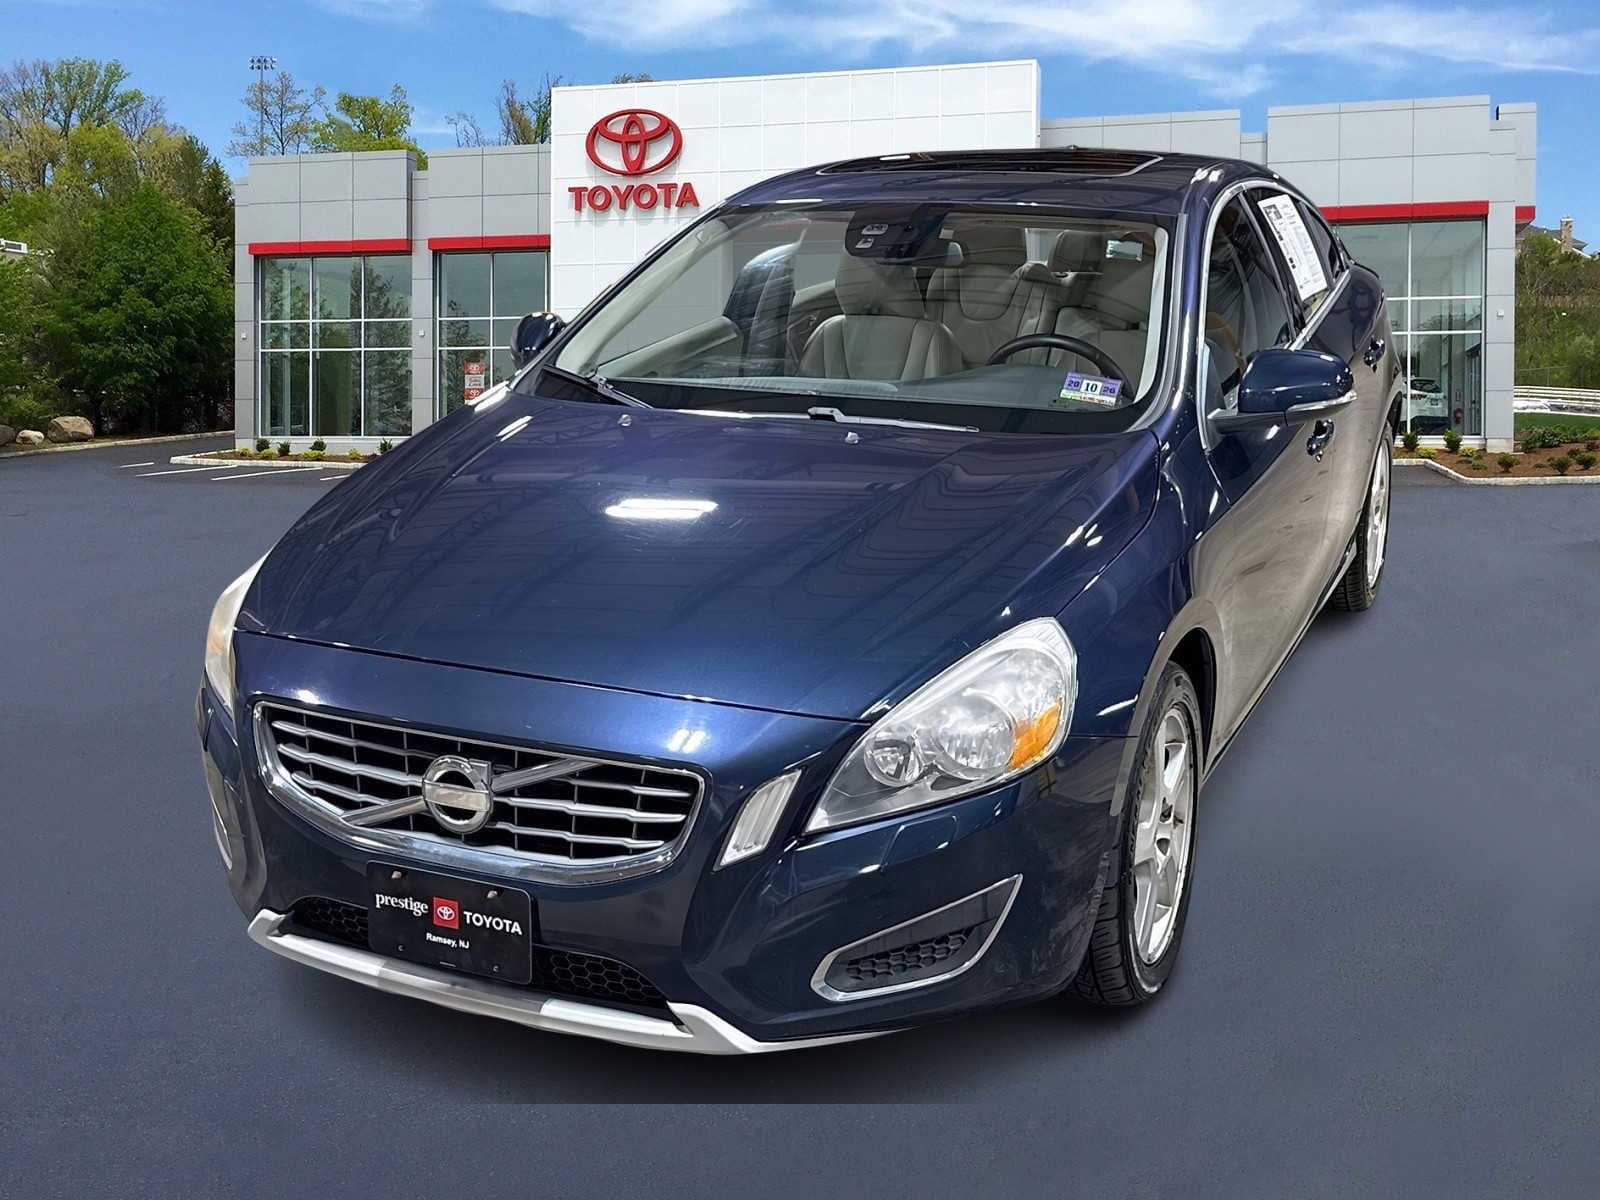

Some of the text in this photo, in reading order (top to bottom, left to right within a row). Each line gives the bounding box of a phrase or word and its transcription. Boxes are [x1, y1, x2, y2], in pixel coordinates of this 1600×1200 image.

[567, 182, 700, 211] TOYOTA
[1085, 382, 1098, 392] 10
[375, 893, 523, 936] prestige TOYOTA
[426, 932, 469, 949] Ramsey, NJ
